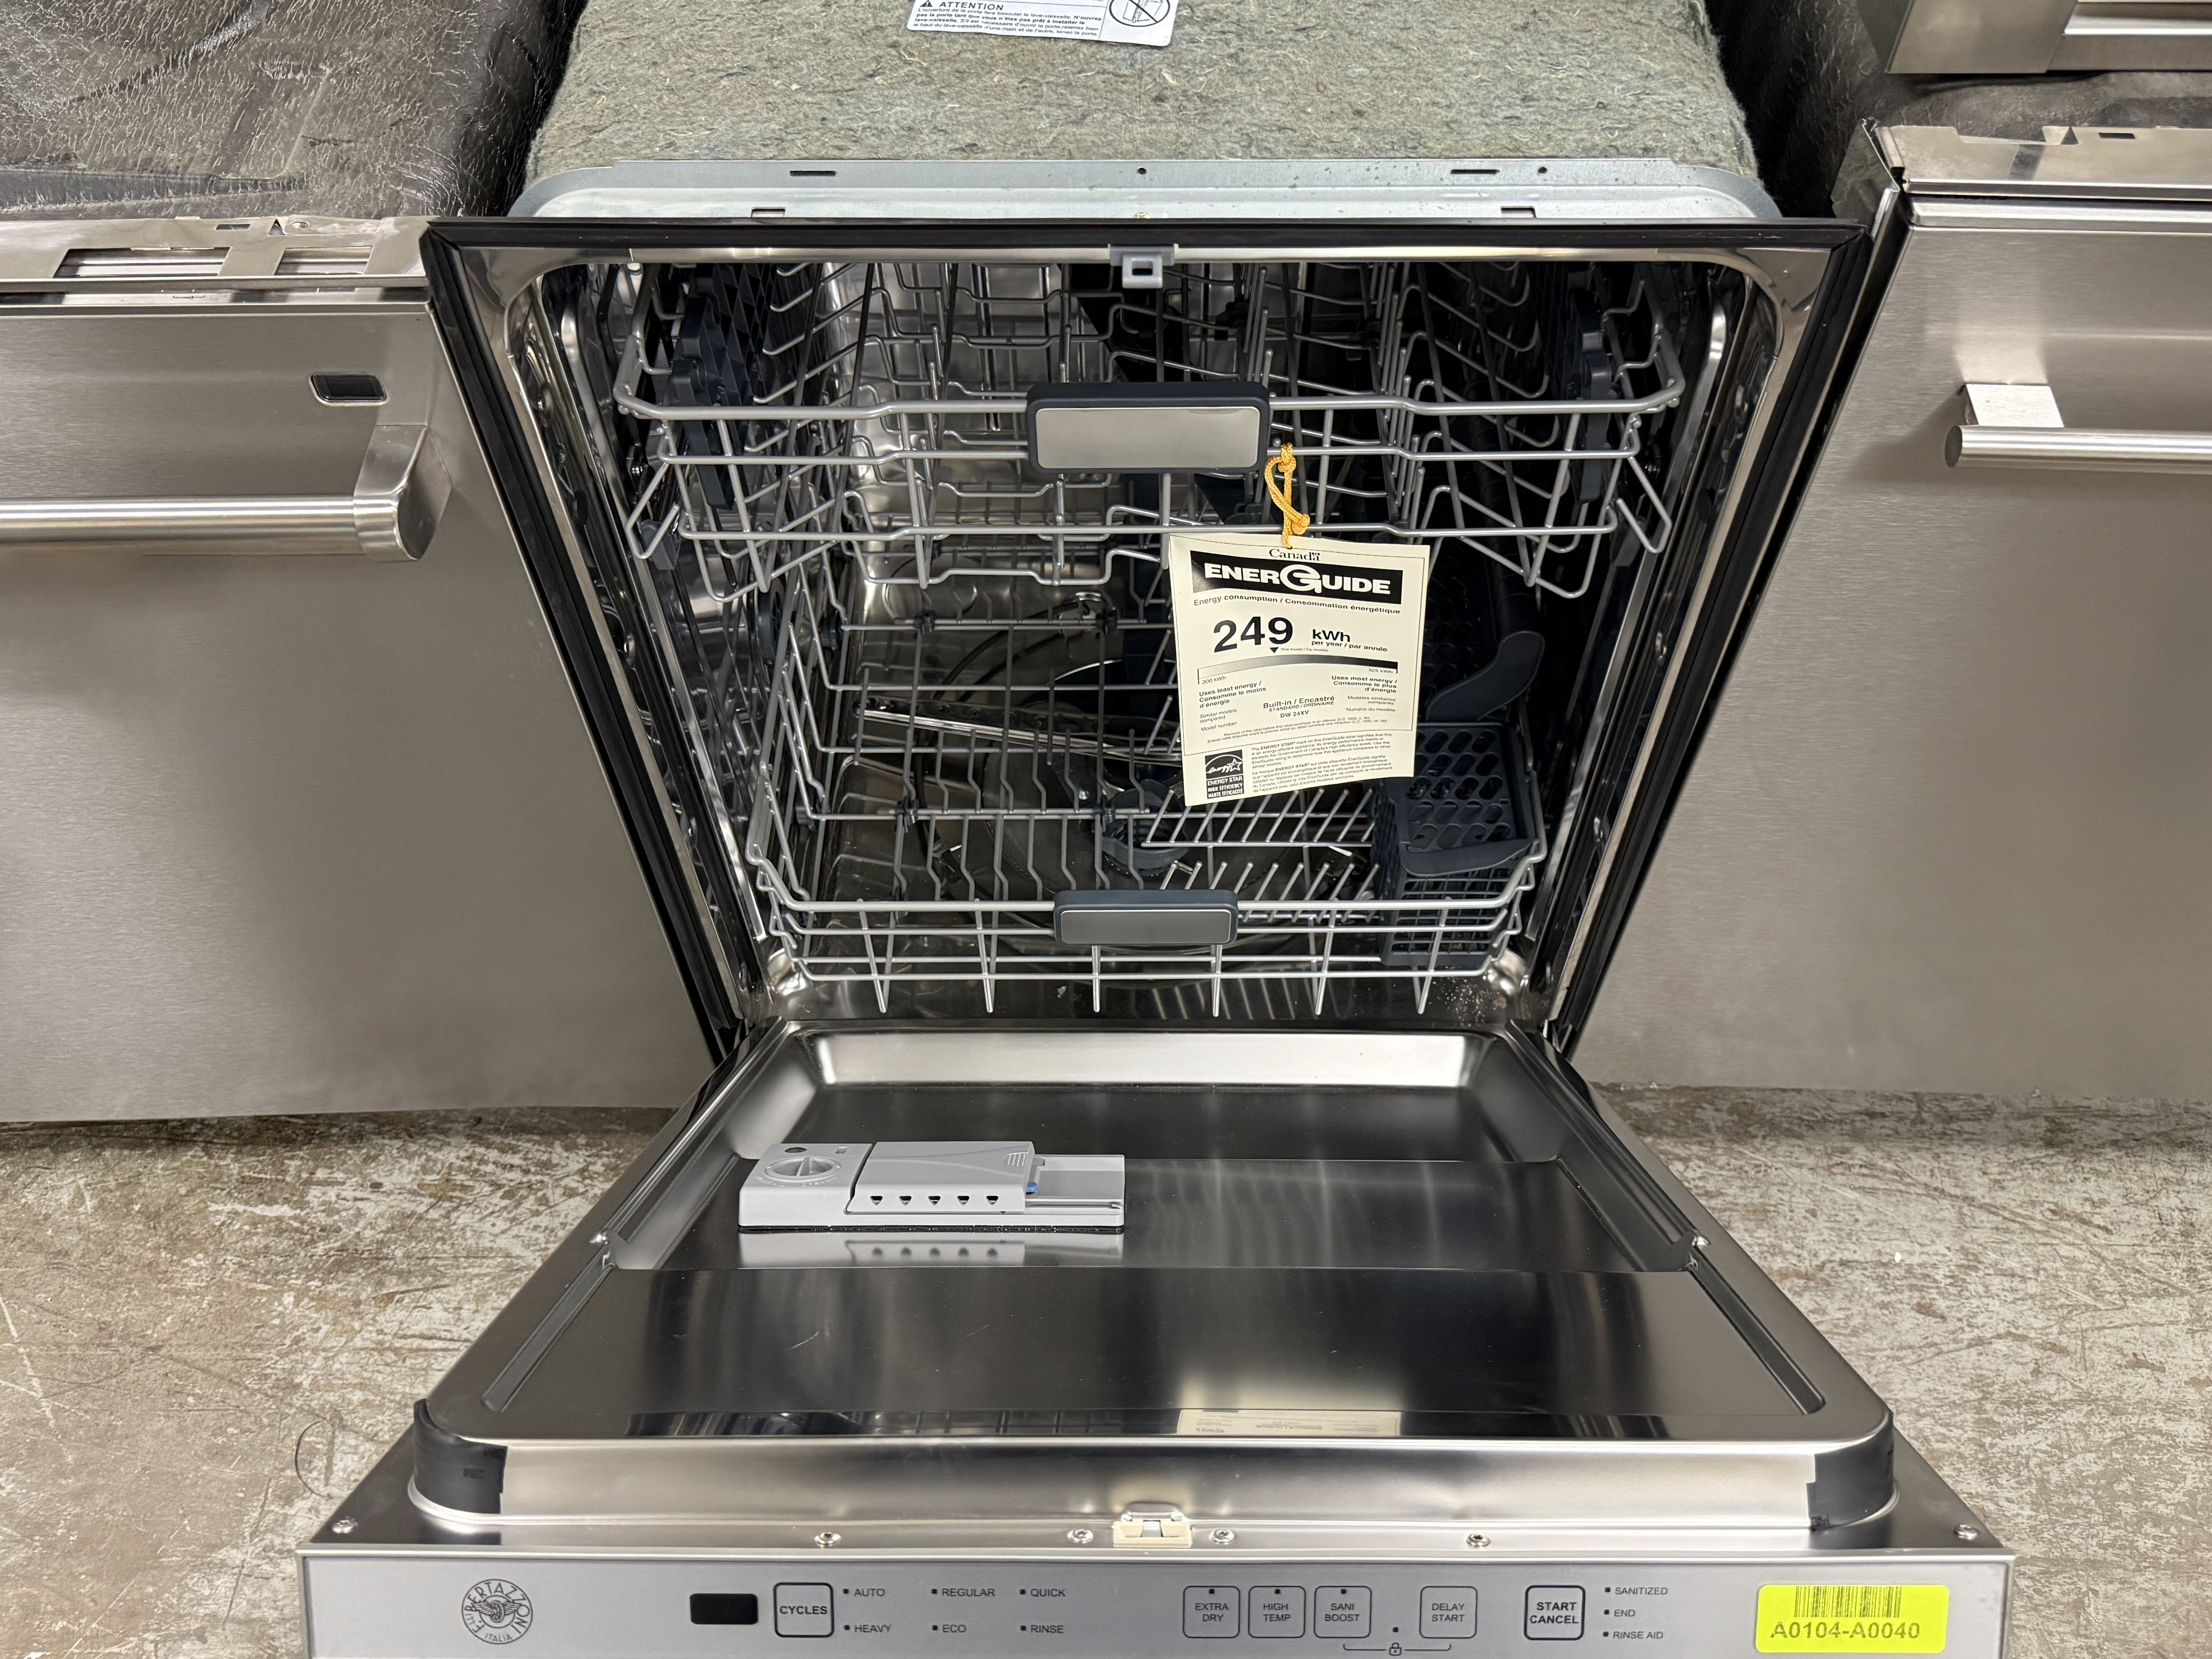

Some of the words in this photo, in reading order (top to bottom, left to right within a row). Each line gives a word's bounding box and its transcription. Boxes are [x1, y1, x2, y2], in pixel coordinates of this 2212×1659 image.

[939, 2, 1003, 10] ATTENTION
[1269, 548, 1321, 561] Canada
[1204, 563, 1390, 594] ENERGUIDE
[1194, 596, 1221, 606] Energy
[1285, 599, 1348, 610] Consommation
[1350, 605, 1400, 614] énergétique
[1214, 617, 1293, 653] 249
[1312, 629, 1350, 642] kWh
[1199, 692, 1237, 702] Consomme
[1200, 699, 1230, 708] d'énergie
[1263, 700, 1291, 708] Built-in
[1299, 696, 1334, 704] Encastré
[1269, 704, 1299, 712] STANDARD
[1200, 715, 1226, 723] compared
[941, 1588, 995, 1596] REGULAR
[1030, 1589, 1066, 1597] QUICK
[1614, 1587, 1668, 1595] SANITIZED
[464, 1582, 530, 1634] BERTAZZONI
[780, 1606, 828, 1614] CYCLES
[1432, 1603, 1465, 1611] DELAY
[1536, 1602, 1577, 1611] START
[1529, 1615, 1579, 1624] CANCEL
[854, 1625, 891, 1633] HEAVY
[942, 1625, 967, 1633] ECO
[1030, 1625, 1064, 1633] RINSE
[1770, 1621, 1920, 1638] A0104-A0040
[485, 1633, 512, 1642] ITALIA
